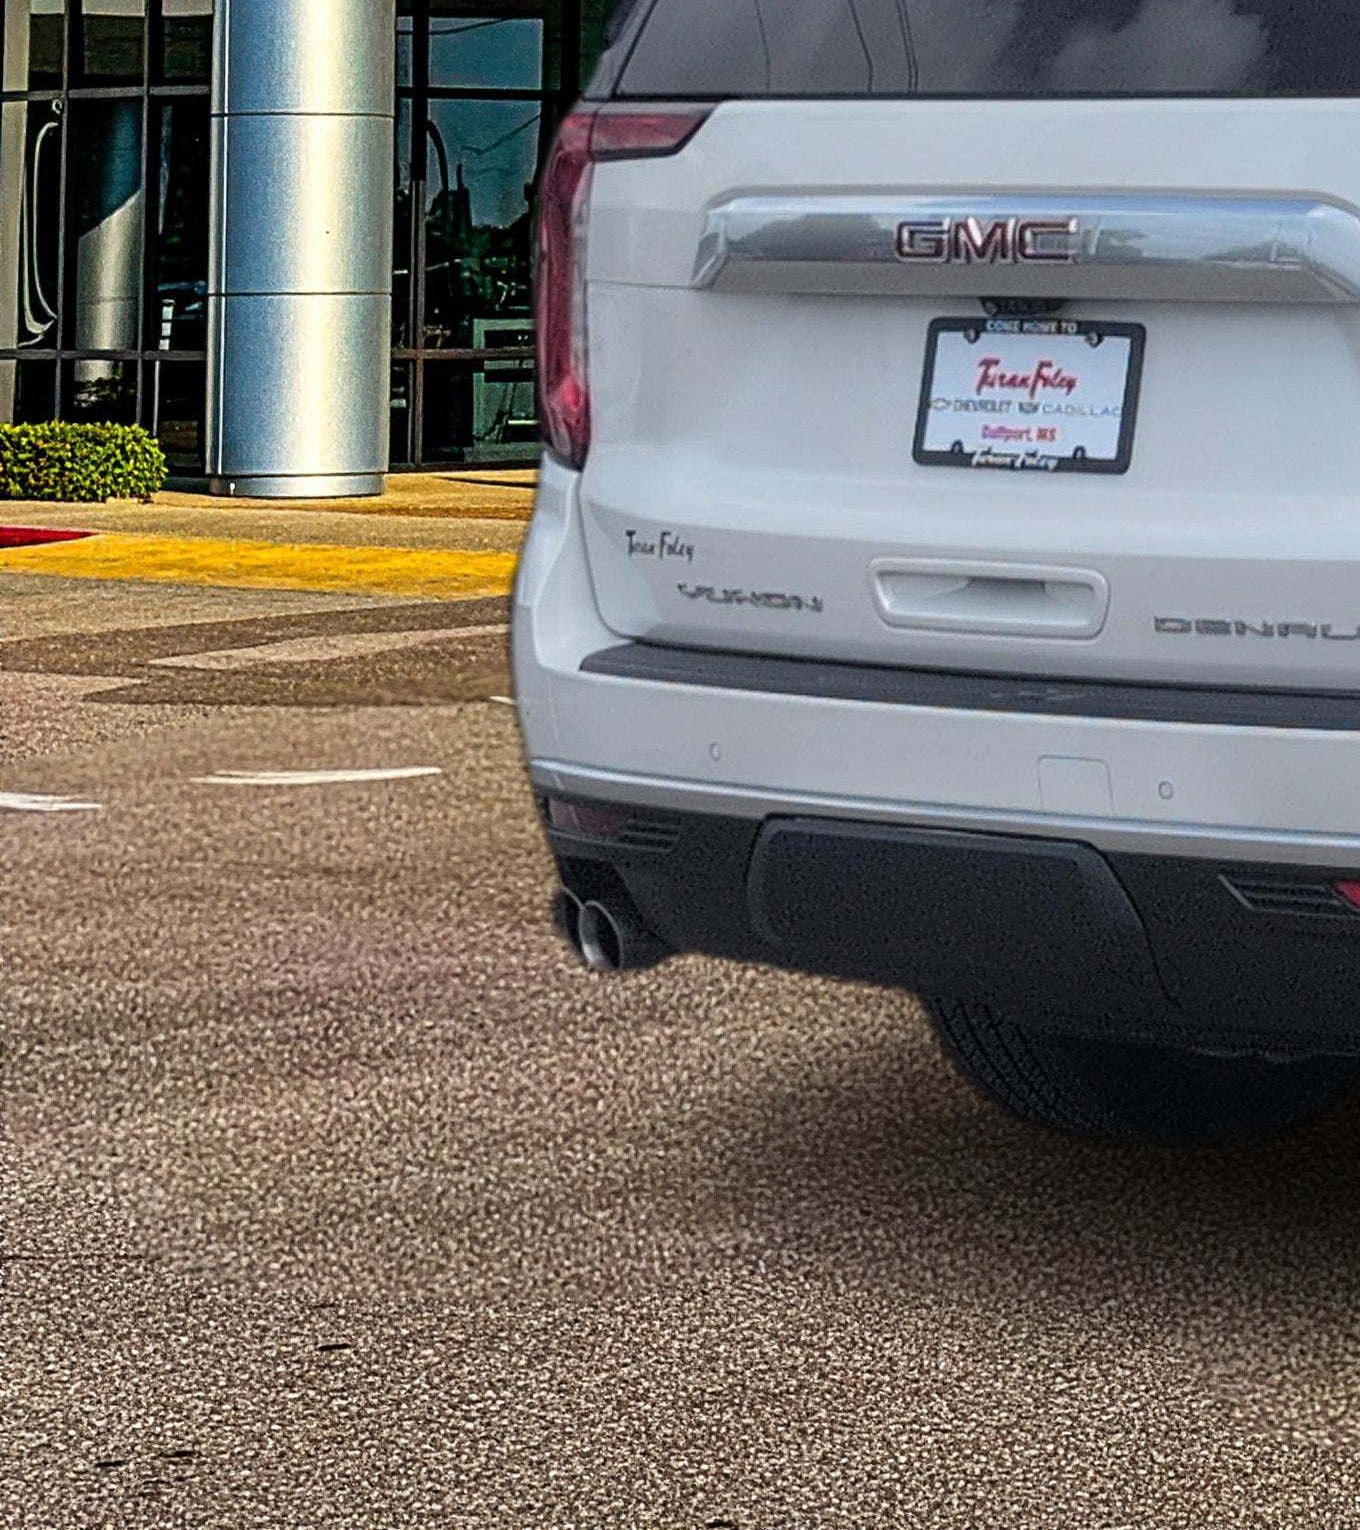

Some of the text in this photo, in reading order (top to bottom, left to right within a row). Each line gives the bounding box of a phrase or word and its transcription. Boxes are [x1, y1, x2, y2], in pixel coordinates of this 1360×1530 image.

[896, 215, 1079, 264] GMC
[1042, 404, 1120, 418] CADILLAC
[676, 582, 824, 613] YUKON
